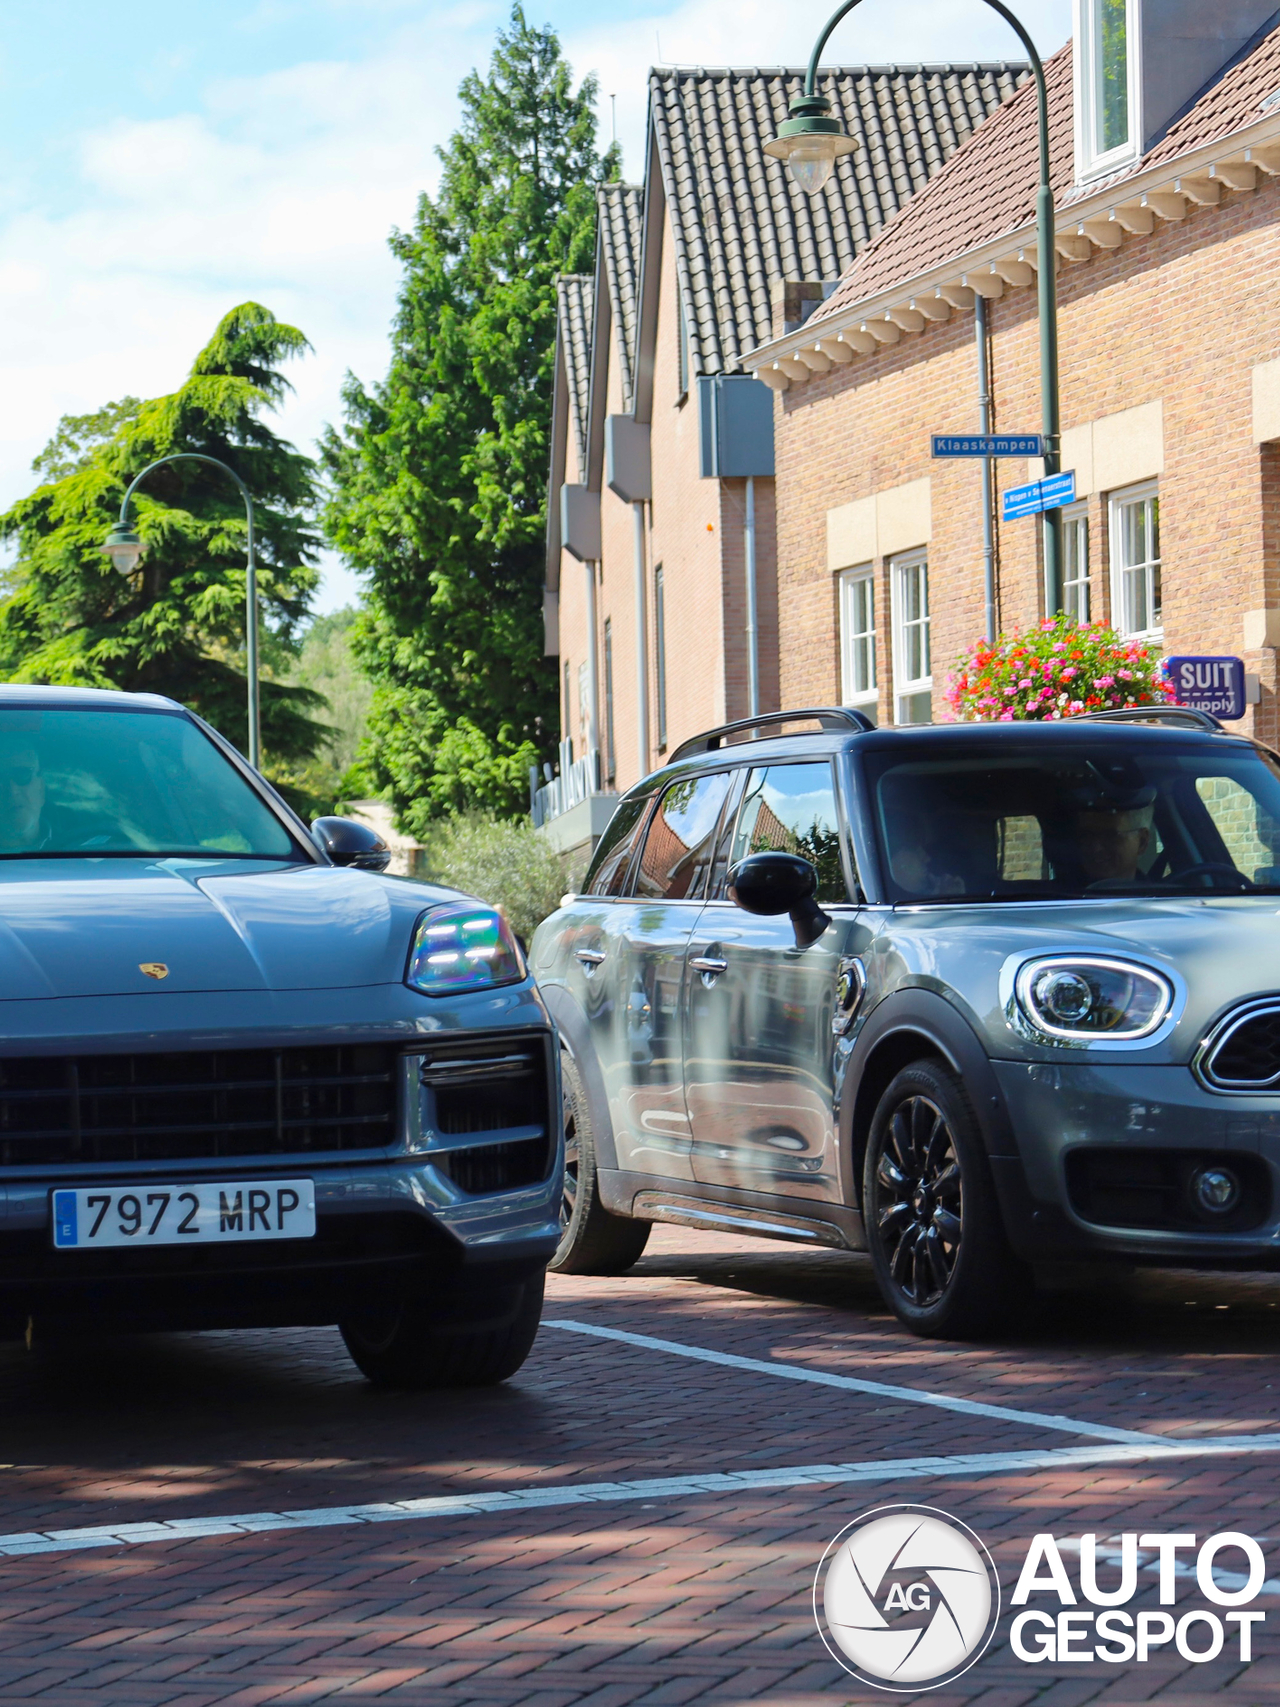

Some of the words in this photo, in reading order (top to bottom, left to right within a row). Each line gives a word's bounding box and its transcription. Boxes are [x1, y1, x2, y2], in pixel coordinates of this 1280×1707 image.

[937, 440, 1035, 452] Klaaskampen
[1009, 491, 1028, 503] Nispen
[1180, 662, 1234, 689] SUIT
[87, 1192, 200, 1238] 7972
[219, 1188, 299, 1233] MRP
[62, 1224, 71, 1236] E
